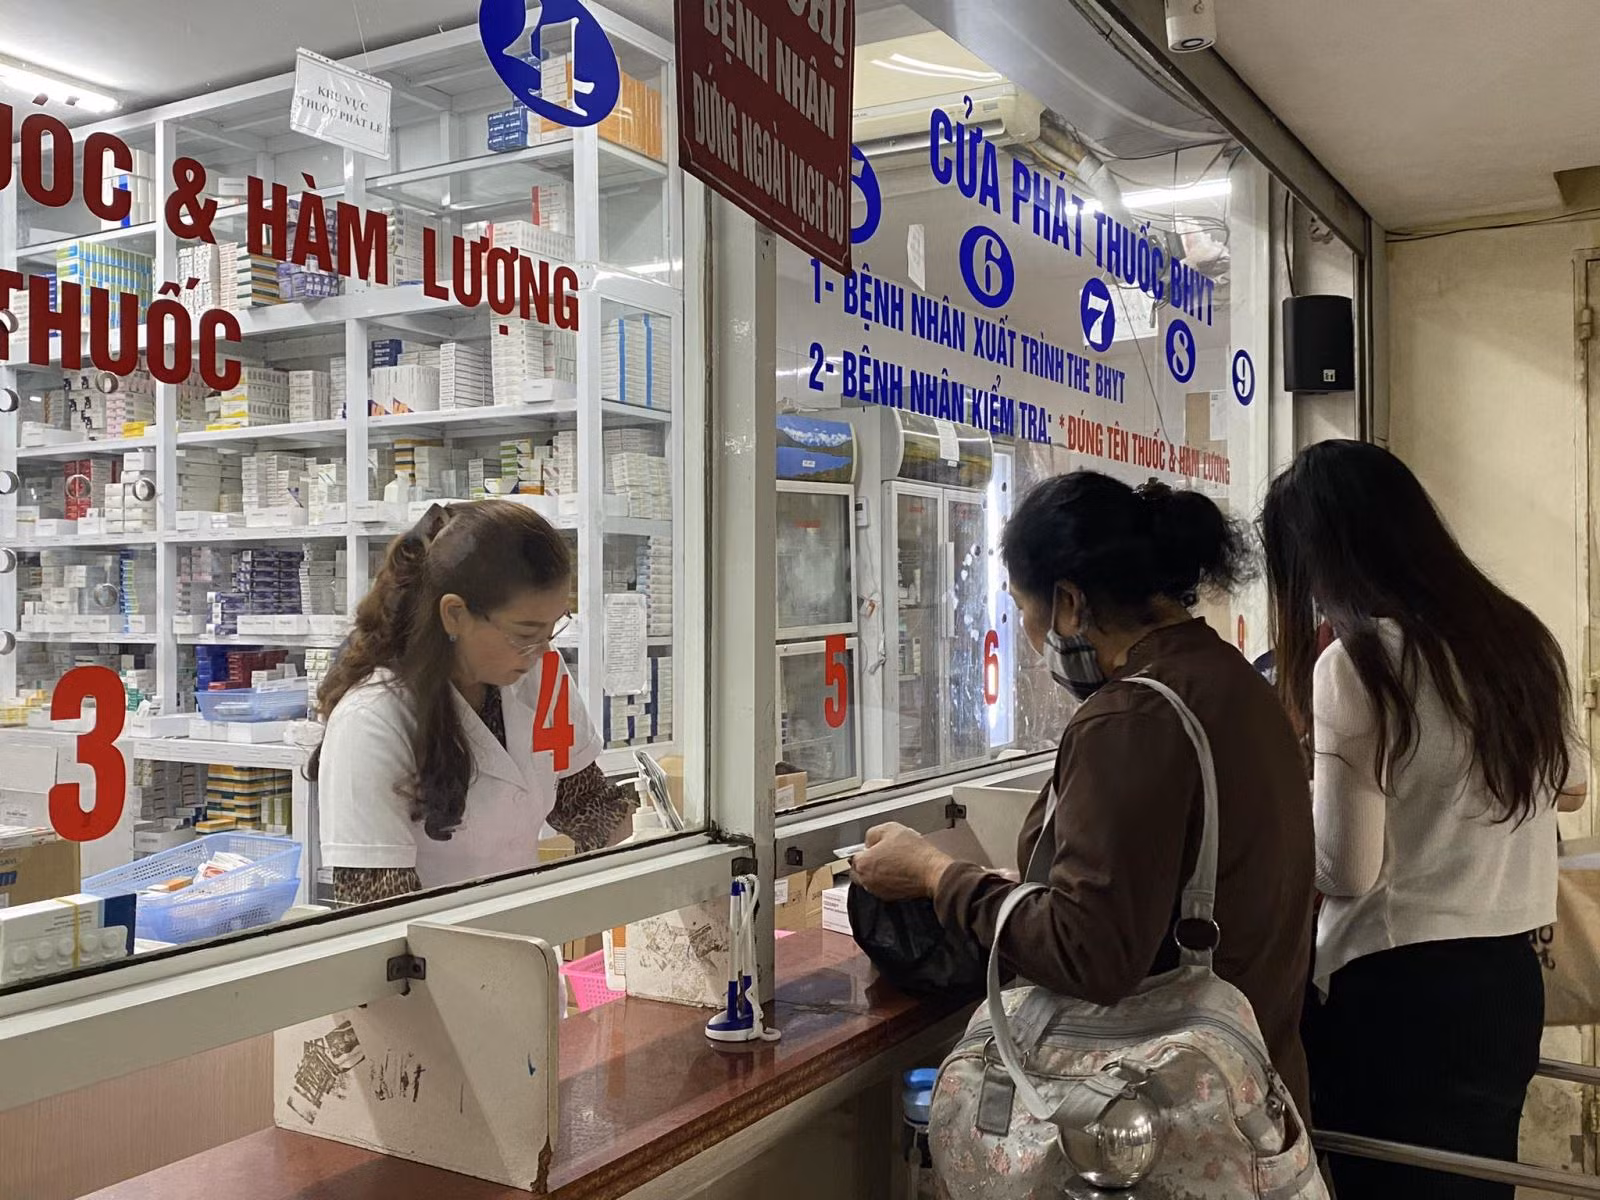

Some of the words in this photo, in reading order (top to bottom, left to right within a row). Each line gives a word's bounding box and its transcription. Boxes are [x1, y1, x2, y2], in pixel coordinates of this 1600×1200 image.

[703, 0, 768, 84] BỆNH
[776, 36, 835, 139] NHÂN
[692, 62, 739, 173] ĐỨNG
[741, 112, 787, 208] NGOÀI
[789, 150, 824, 233] VẠCH
[827, 165, 844, 245] ĐỎ
[930, 95, 1001, 215] CỬA
[1012, 158, 1086, 257] PHÁT
[1093, 209, 1164, 300] THUỐC
[1170, 256, 1215, 327] BHYT
[165, 157, 218, 245] &
[247, 171, 388, 285] HÀM
[423, 227, 579, 336] LƯỢNG
[843, 344, 903, 413] BỆNH
[910, 367, 965, 423] NHÂN
[972, 374, 1015, 437] KIỂM
[1019, 401, 1052, 445] TRA:
[844, 262, 904, 332] BỆNH
[911, 292, 966, 353] NHÂN
[973, 314, 1016, 369] XUẤT
[1020, 331, 1064, 385] TRÌNH
[1095, 362, 1125, 404] BHYT
[1106, 421, 1129, 463] TÊN
[1131, 428, 1166, 471] THUỐC
[1168, 443, 1177, 473] &
[532, 650, 574, 772] 4
[825, 633, 848, 728] 5
[984, 629, 999, 705] 6
[48, 665, 127, 842] 3
